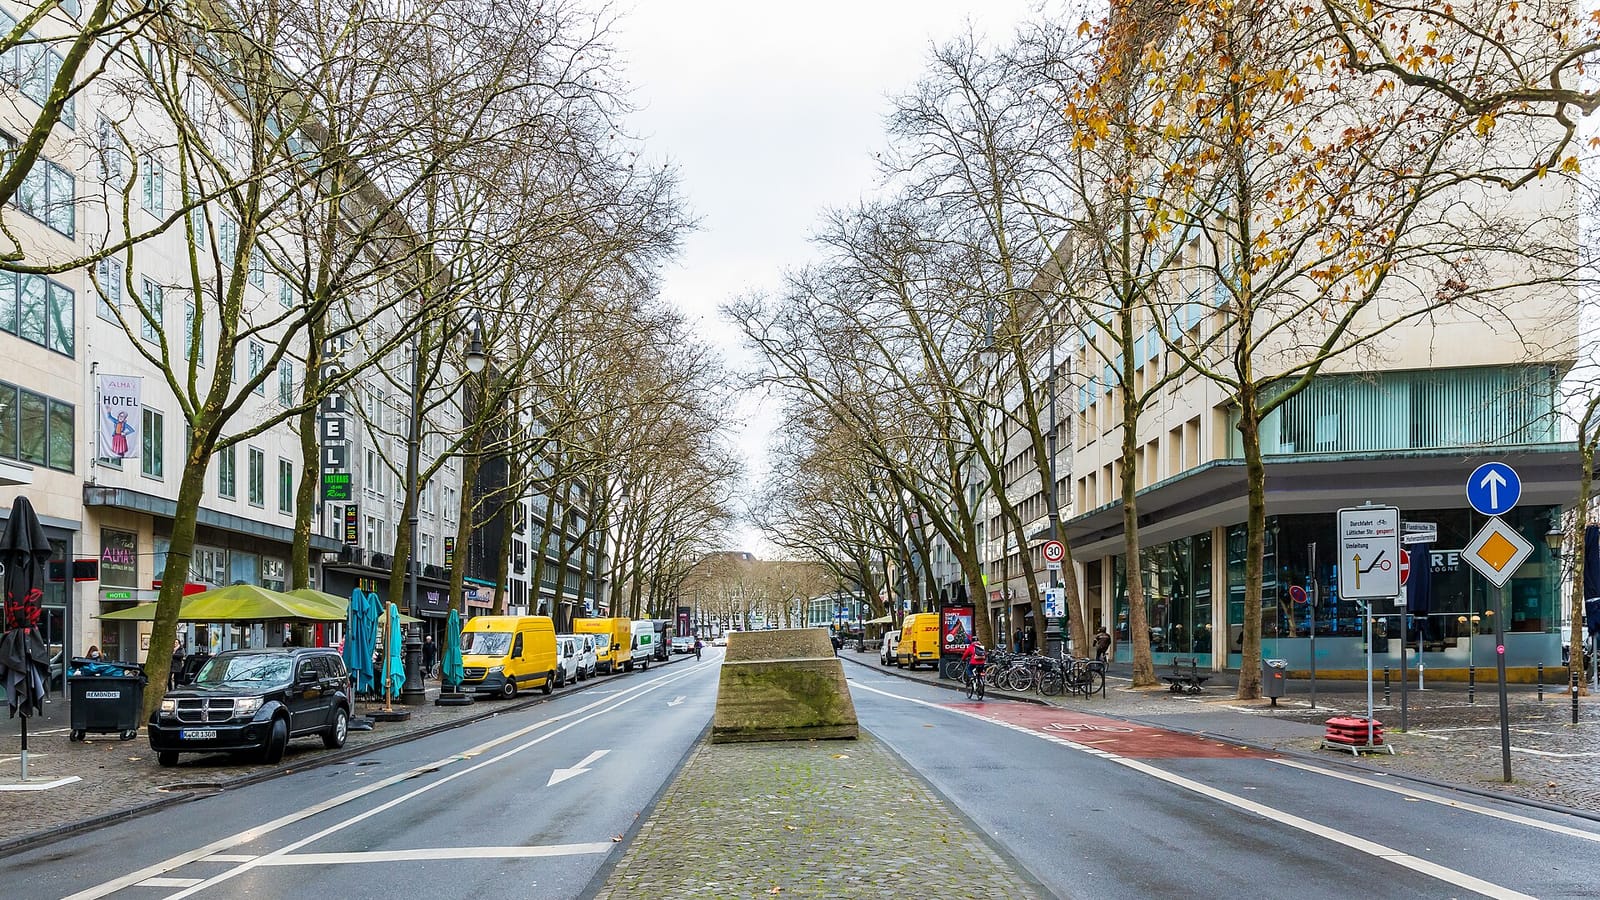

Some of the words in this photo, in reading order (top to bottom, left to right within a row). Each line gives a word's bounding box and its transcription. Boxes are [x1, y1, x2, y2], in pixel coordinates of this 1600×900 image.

[103, 395, 138, 407] HOTEL
[325, 337, 341, 465] HOTEL
[326, 489, 347, 499] Ring
[1047, 546, 1061, 557] 30
[1431, 553, 1459, 567] RE
